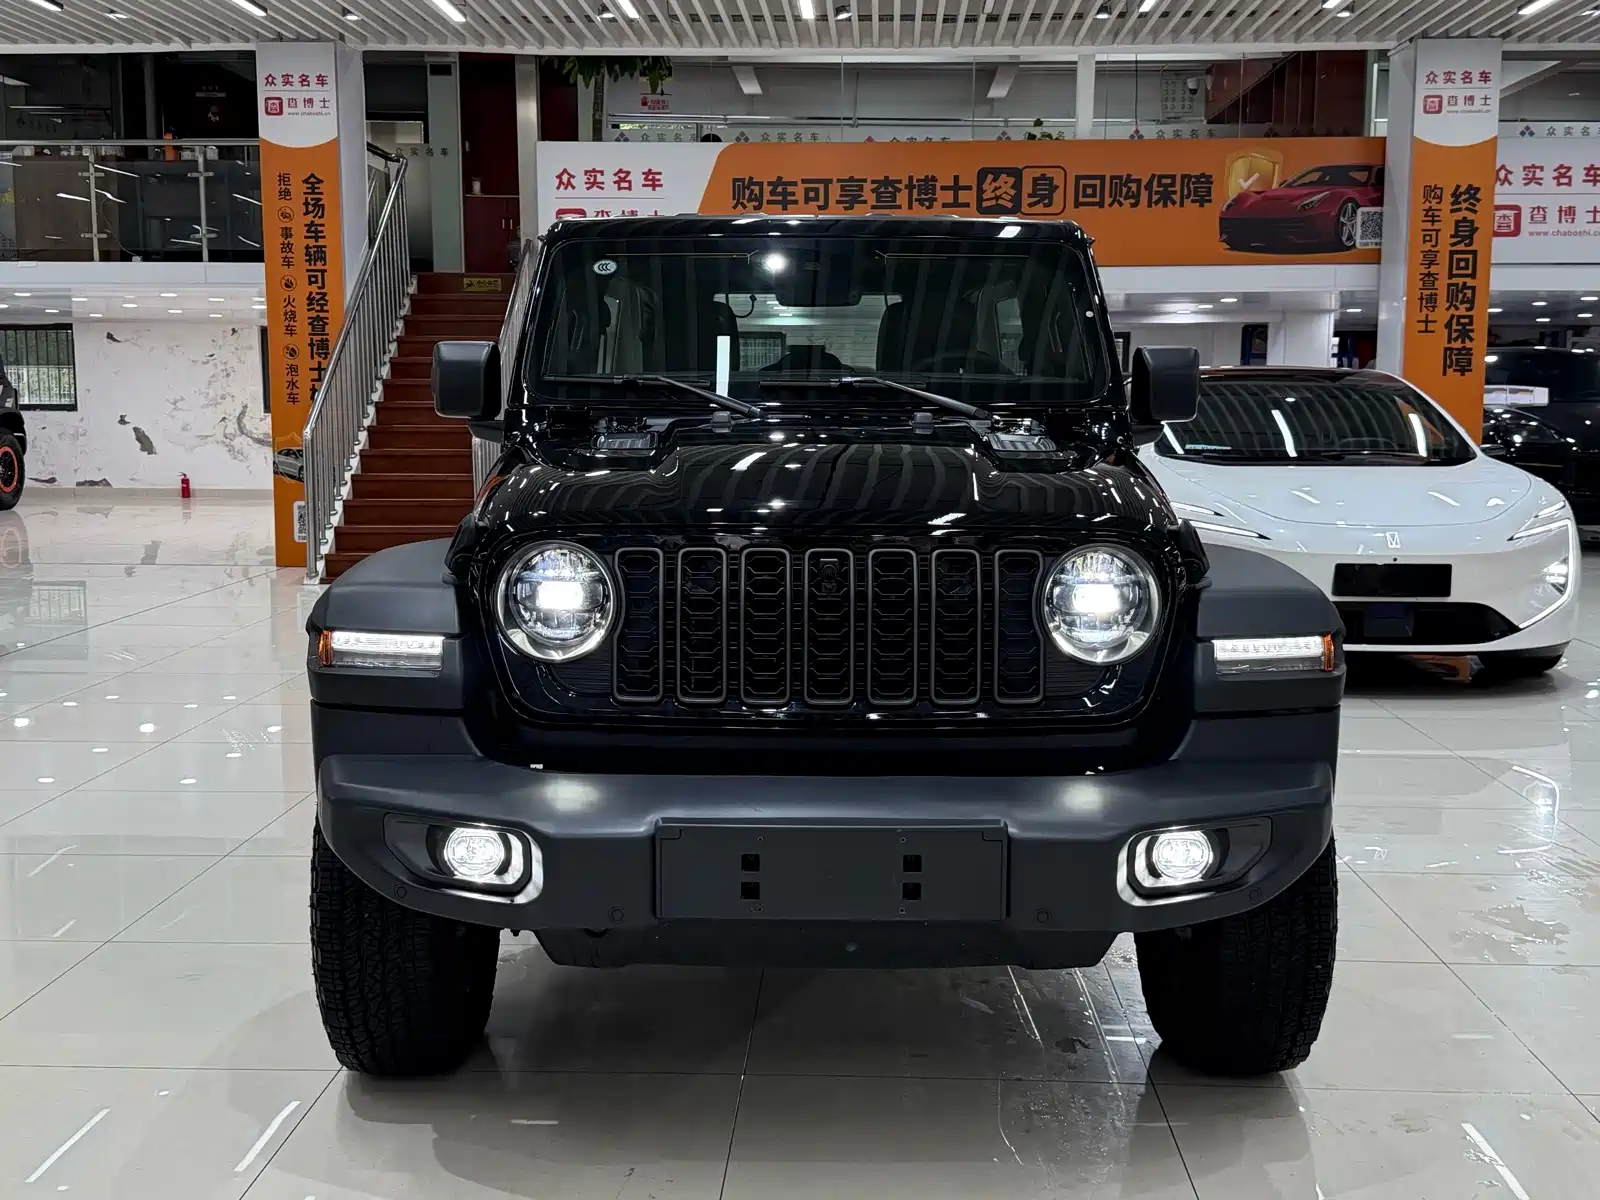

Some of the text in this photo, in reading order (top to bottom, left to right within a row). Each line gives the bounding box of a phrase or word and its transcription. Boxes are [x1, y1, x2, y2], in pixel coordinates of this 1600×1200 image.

[264, 73, 328, 87] 众实名车
[1425, 70, 1492, 84] 众实名车
[1447, 95, 1492, 107] 查博士
[1546, 125, 1600, 137] 众实名
[555, 167, 664, 191] 众实名车
[1496, 163, 1600, 187] 众实名车
[1528, 205, 1600, 224] 查博士
[1416, 184, 1444, 334] 购车可享查博士
[277, 172, 300, 405] 拒绝 事故车 火烧车 泡水车
[1442, 184, 1482, 377] 终身回购保障
